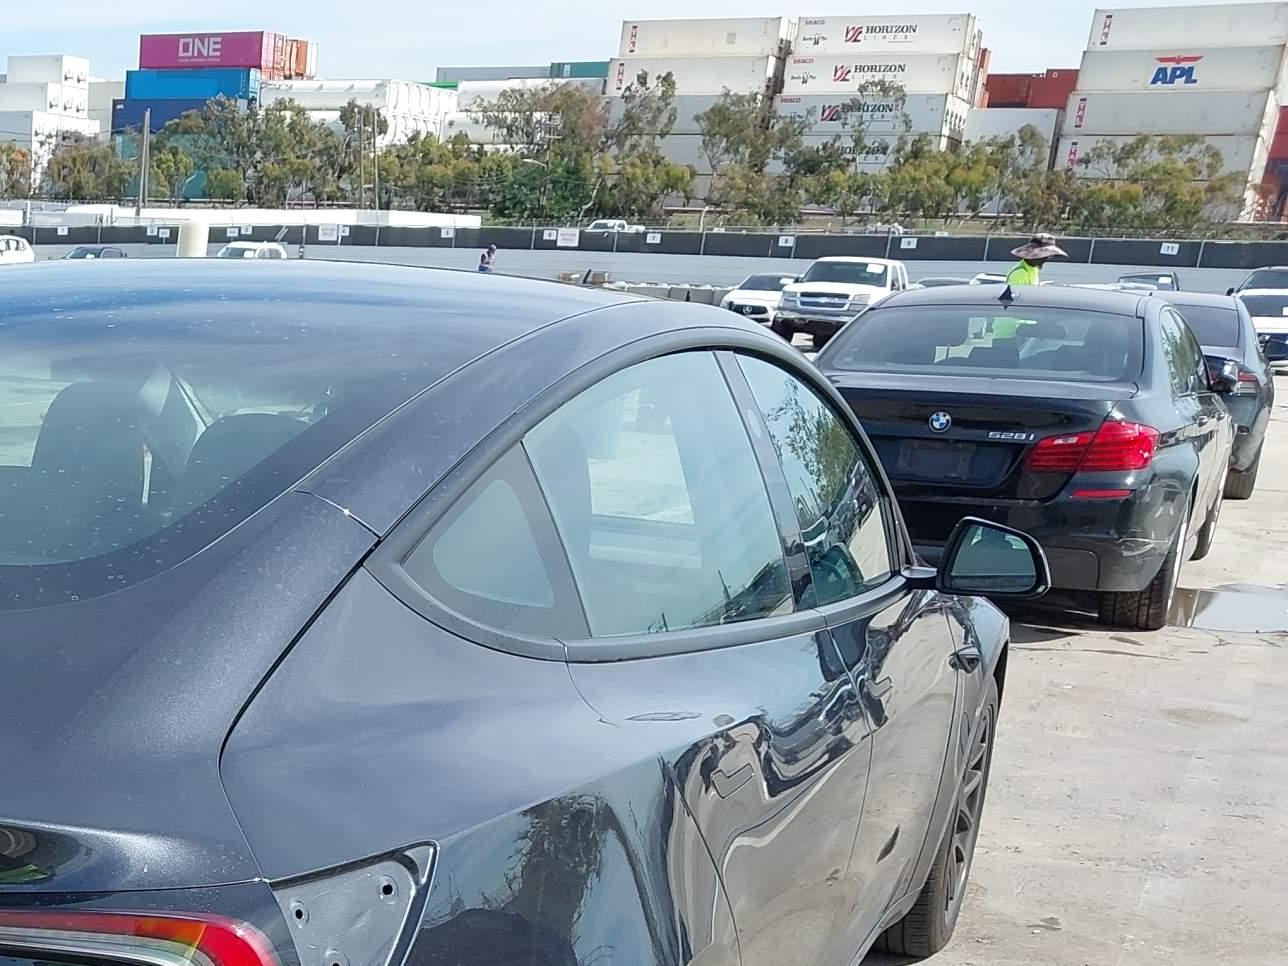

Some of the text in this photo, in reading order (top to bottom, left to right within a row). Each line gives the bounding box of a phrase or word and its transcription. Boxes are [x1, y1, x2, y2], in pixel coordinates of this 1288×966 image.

[865, 24, 918, 34] HORIZON
[178, 37, 222, 57] ONE
[853, 64, 907, 73] HORIZON
[1150, 66, 1198, 85] APL
